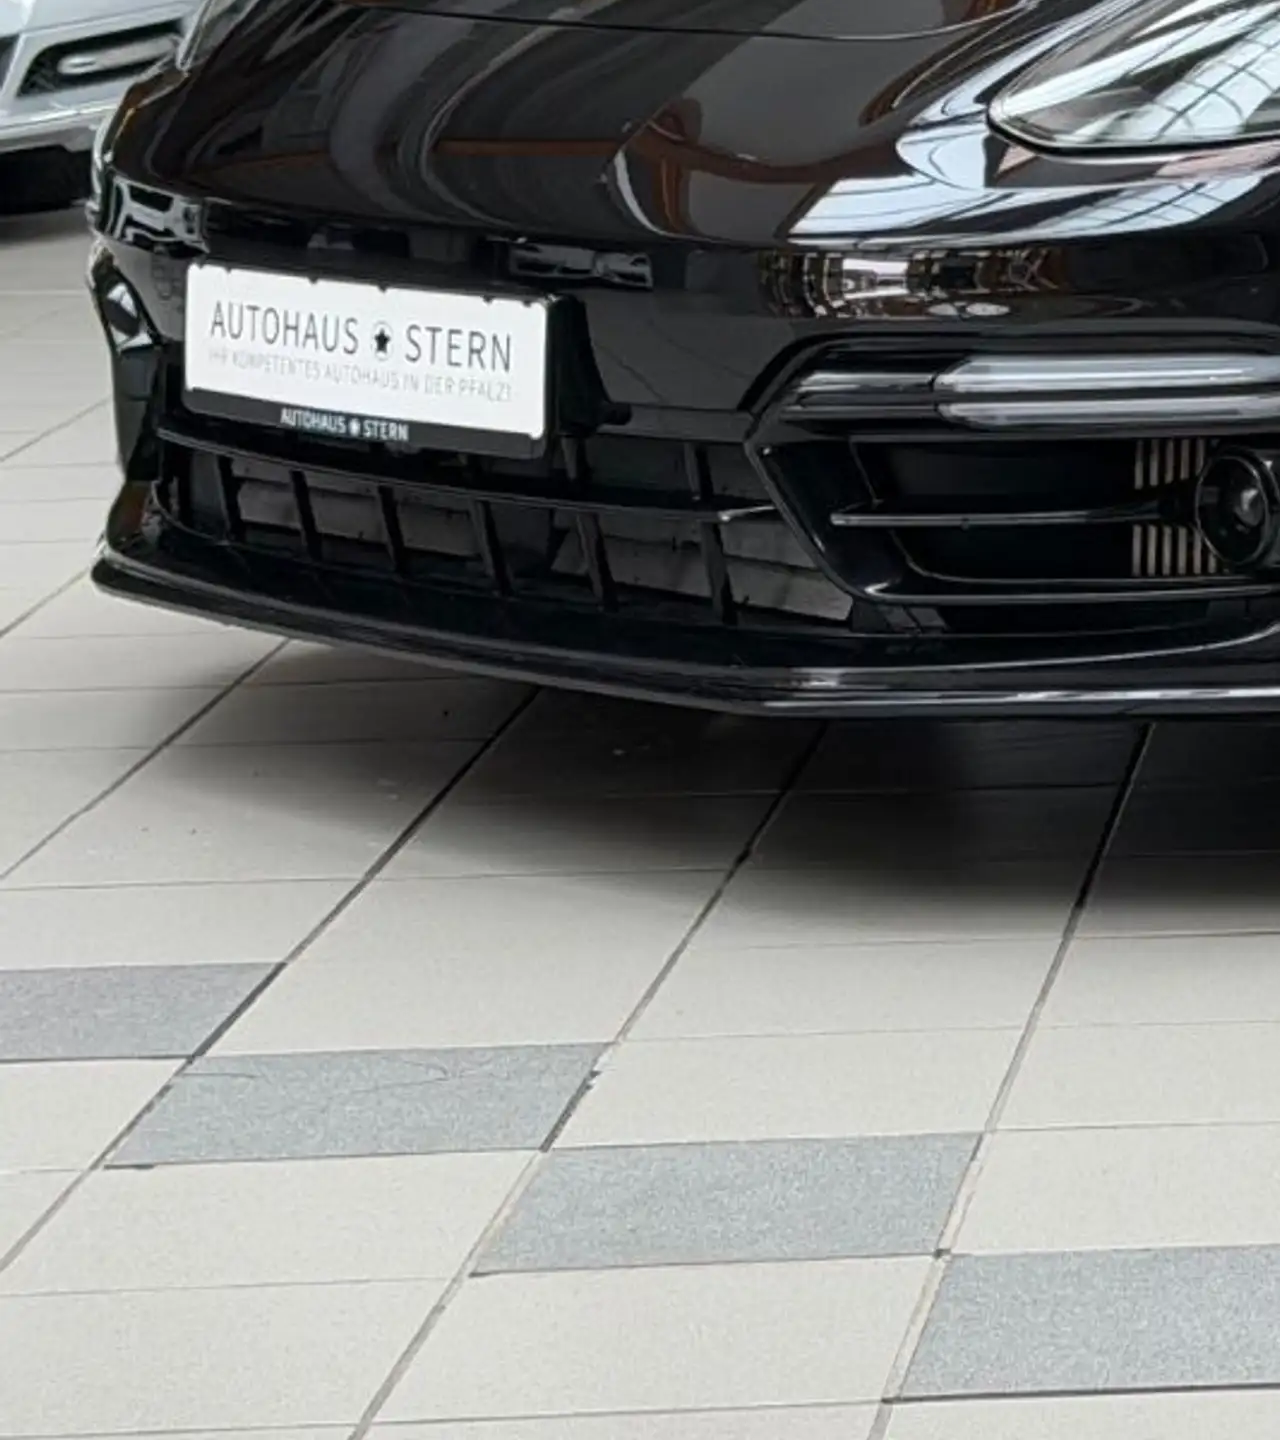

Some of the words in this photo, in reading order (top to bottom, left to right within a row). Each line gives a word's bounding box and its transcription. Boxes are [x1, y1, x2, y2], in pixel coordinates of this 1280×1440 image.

[210, 300, 359, 355] AUTOHAUS
[404, 323, 511, 373] STERN
[324, 361, 400, 391] AUTOHAUS
[402, 373, 419, 392] IN
[424, 374, 455, 397] DER
[280, 406, 346, 434] AUTOHAUS
[363, 419, 409, 441] STERN
